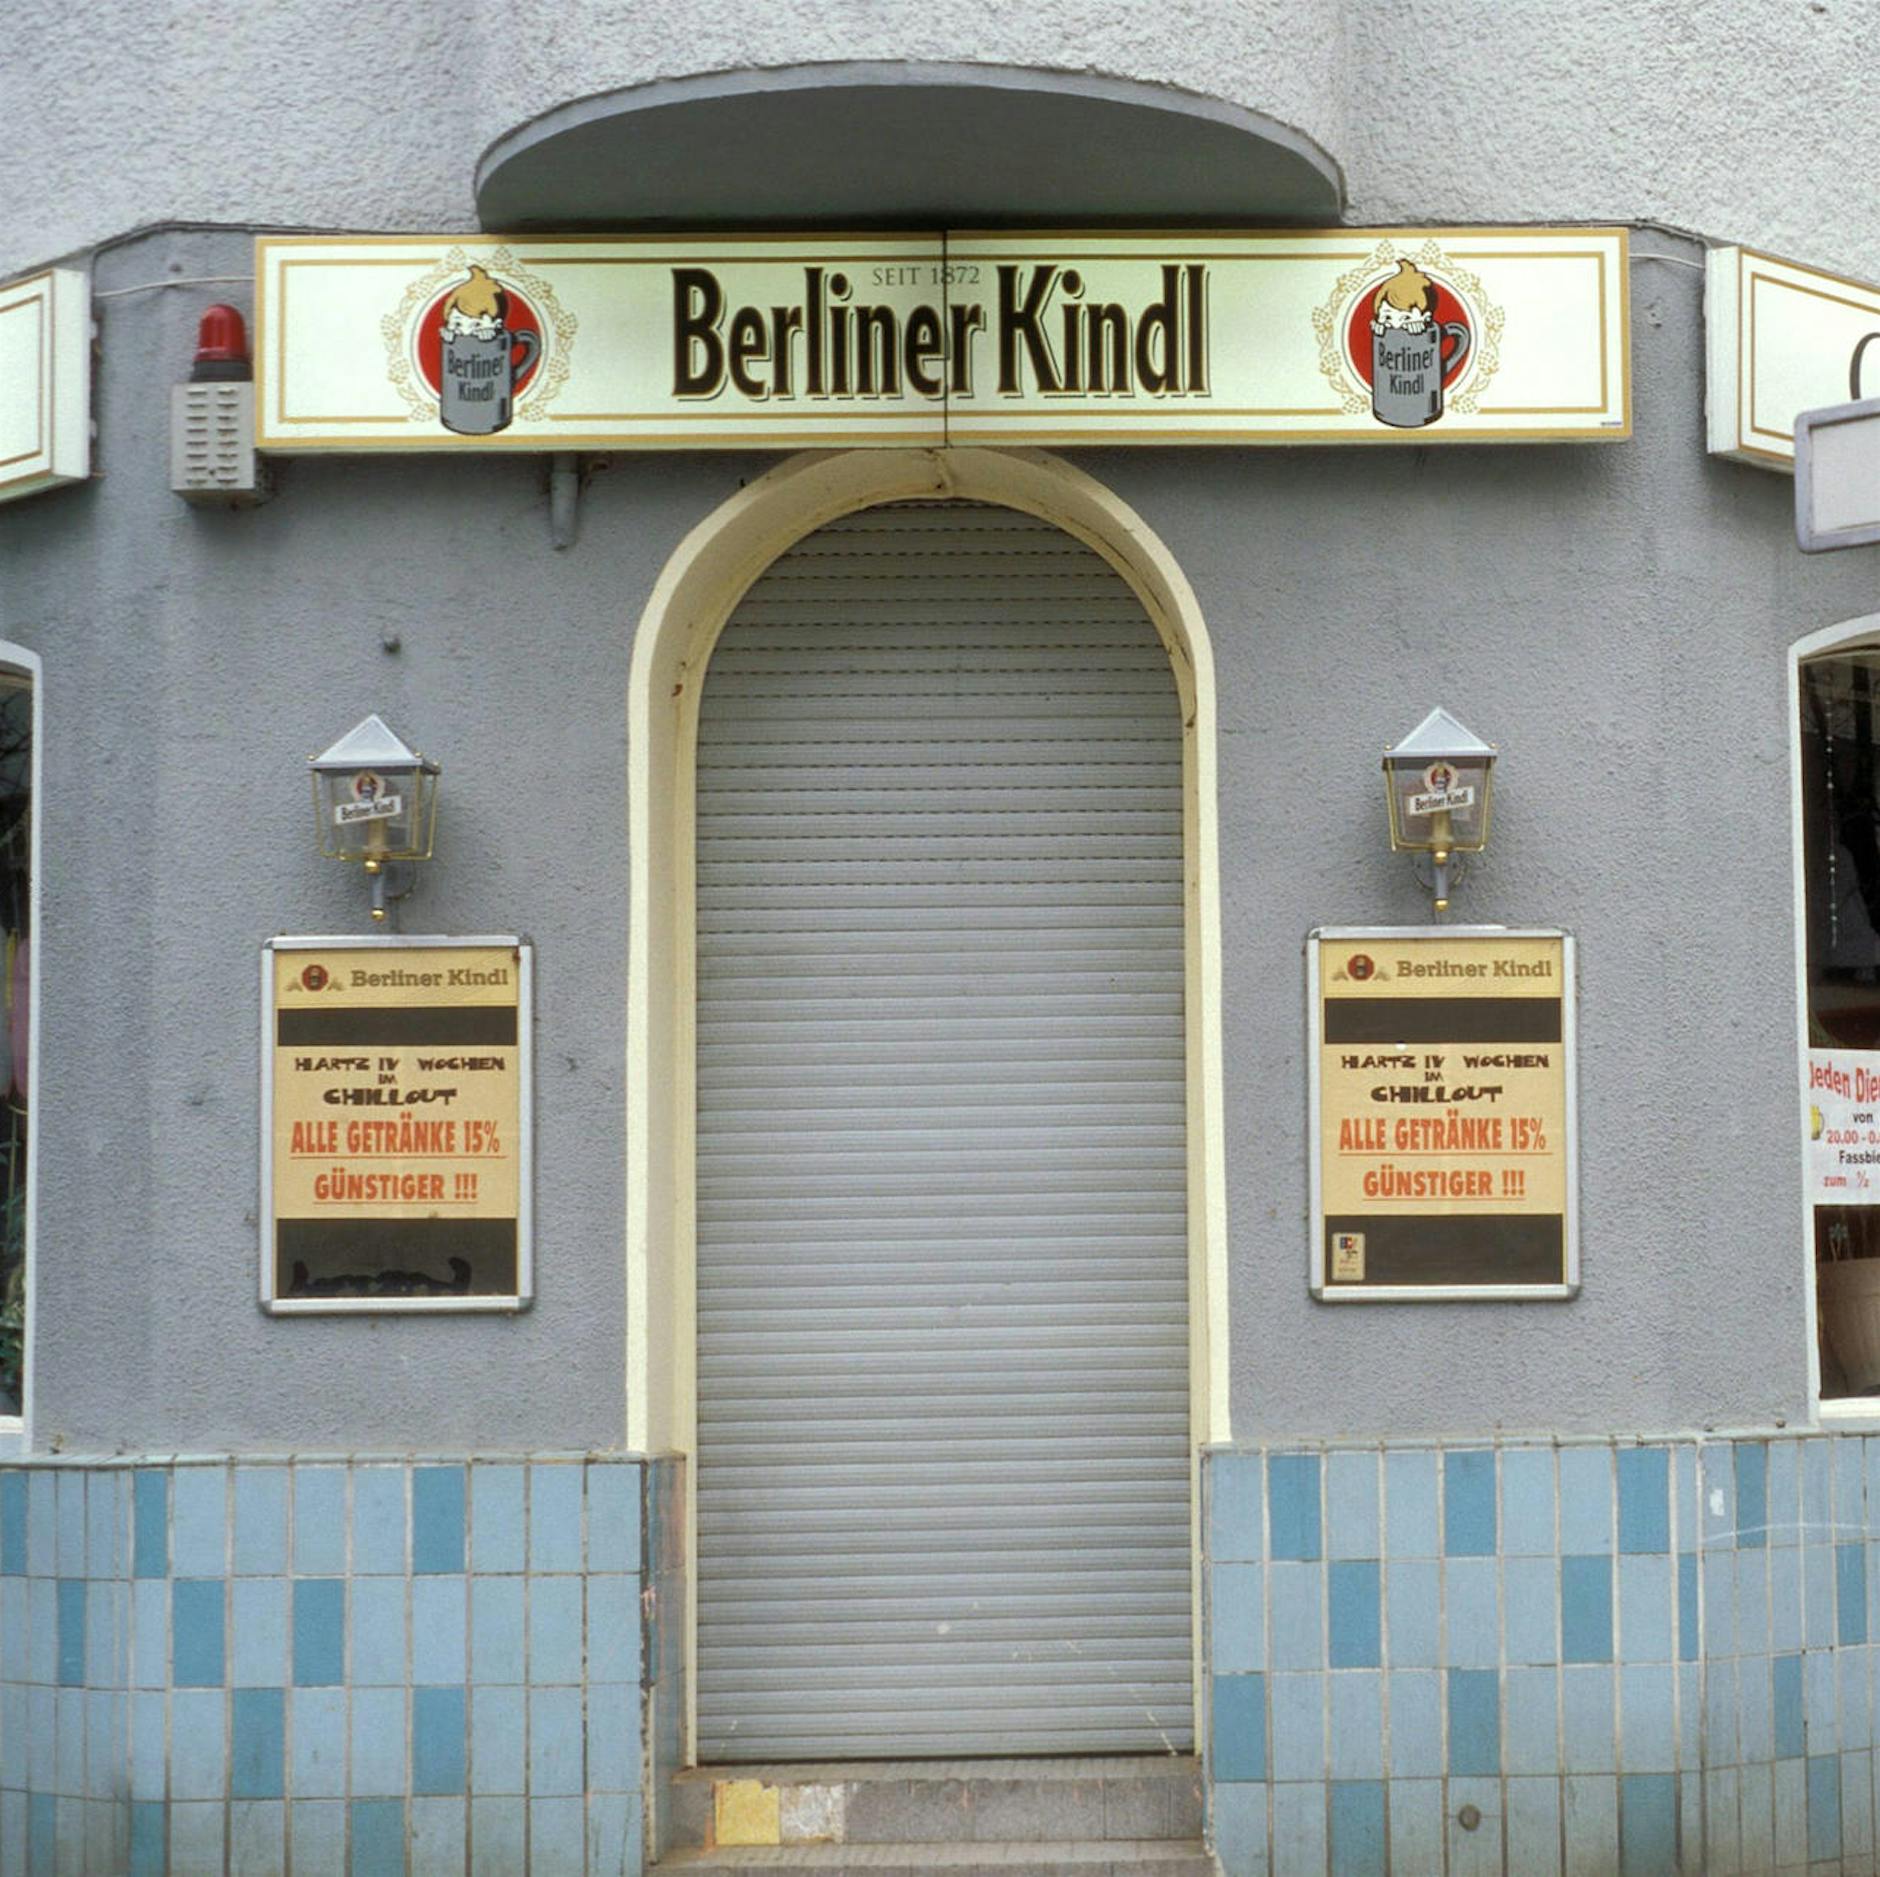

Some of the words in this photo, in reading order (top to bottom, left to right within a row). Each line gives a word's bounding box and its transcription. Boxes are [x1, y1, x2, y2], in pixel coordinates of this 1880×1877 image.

[872, 267, 922, 286] SEIT
[931, 266, 980, 285] 1872
[672, 266, 986, 402] Berliner
[997, 264, 1212, 400] Kindl
[447, 349, 505, 379] Berliner
[1377, 341, 1434, 373] Berliner
[458, 381, 495, 402] Kindl
[1389, 373, 1425, 395] Kindl
[350, 968, 443, 988] Berliner
[447, 967, 509, 987] Kindl
[1396, 958, 1488, 978] Berliner
[1493, 959, 1553, 978] Kindl
[294, 1056, 371, 1072] HARTZ
[378, 1056, 401, 1072] IV
[417, 1056, 506, 1071] WOCHEN
[1341, 1054, 1417, 1070] HARTZ
[1424, 1054, 1446, 1069] IV
[1462, 1054, 1550, 1069] WOCHEN
[377, 1073, 398, 1086] IM
[1424, 1071, 1444, 1083] IM
[1855, 1067, 1880, 1103] Die
[324, 1088, 457, 1105] CHILLOUT
[1371, 1086, 1503, 1103] CHILLOUT
[1853, 1113, 1873, 1124] von
[290, 1121, 338, 1153] ALLE
[346, 1111, 456, 1154] GETRÄNKE
[463, 1119, 501, 1154] 15%
[1339, 1118, 1387, 1151] ALLE
[1394, 1108, 1502, 1151] GETRÄNKE
[1510, 1117, 1547, 1150] 15%
[1827, 1130, 1859, 1144] 20.00
[313, 1166, 445, 1201] GÜNSTIGER
[453, 1173, 478, 1200] !!!
[1363, 1164, 1494, 1198] GÜNSTIGER
[1502, 1170, 1525, 1196] !!!
[1824, 1175, 1847, 1188] zum
